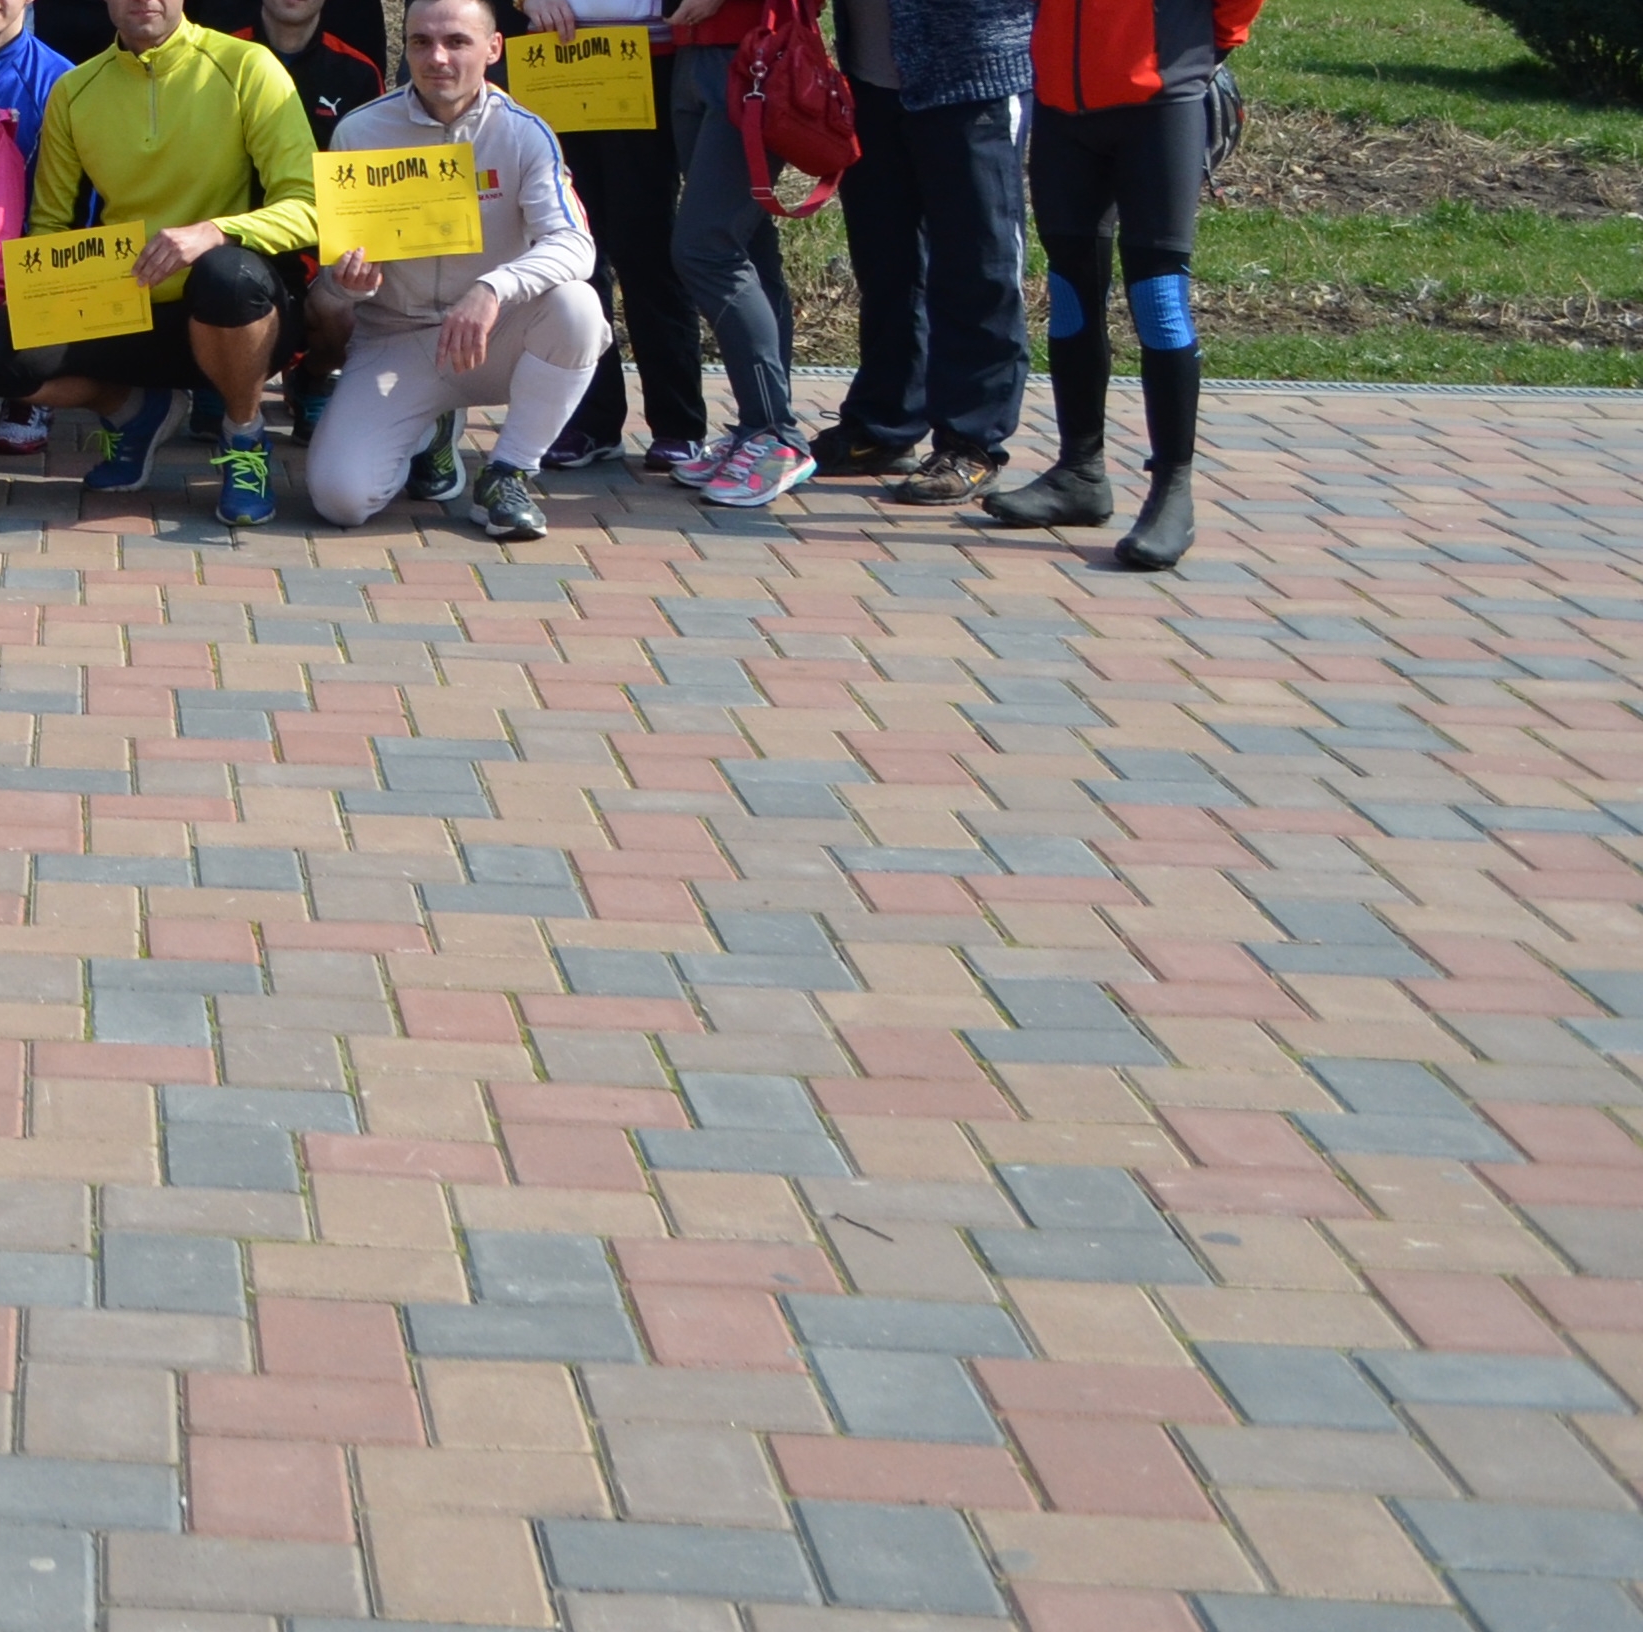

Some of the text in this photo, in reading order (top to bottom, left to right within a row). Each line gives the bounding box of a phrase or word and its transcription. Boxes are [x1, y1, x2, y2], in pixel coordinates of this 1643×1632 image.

[555, 36, 612, 64] DIPLOMA
[366, 157, 429, 187] DIPLOMA
[51, 237, 106, 268] DIPLOMA
